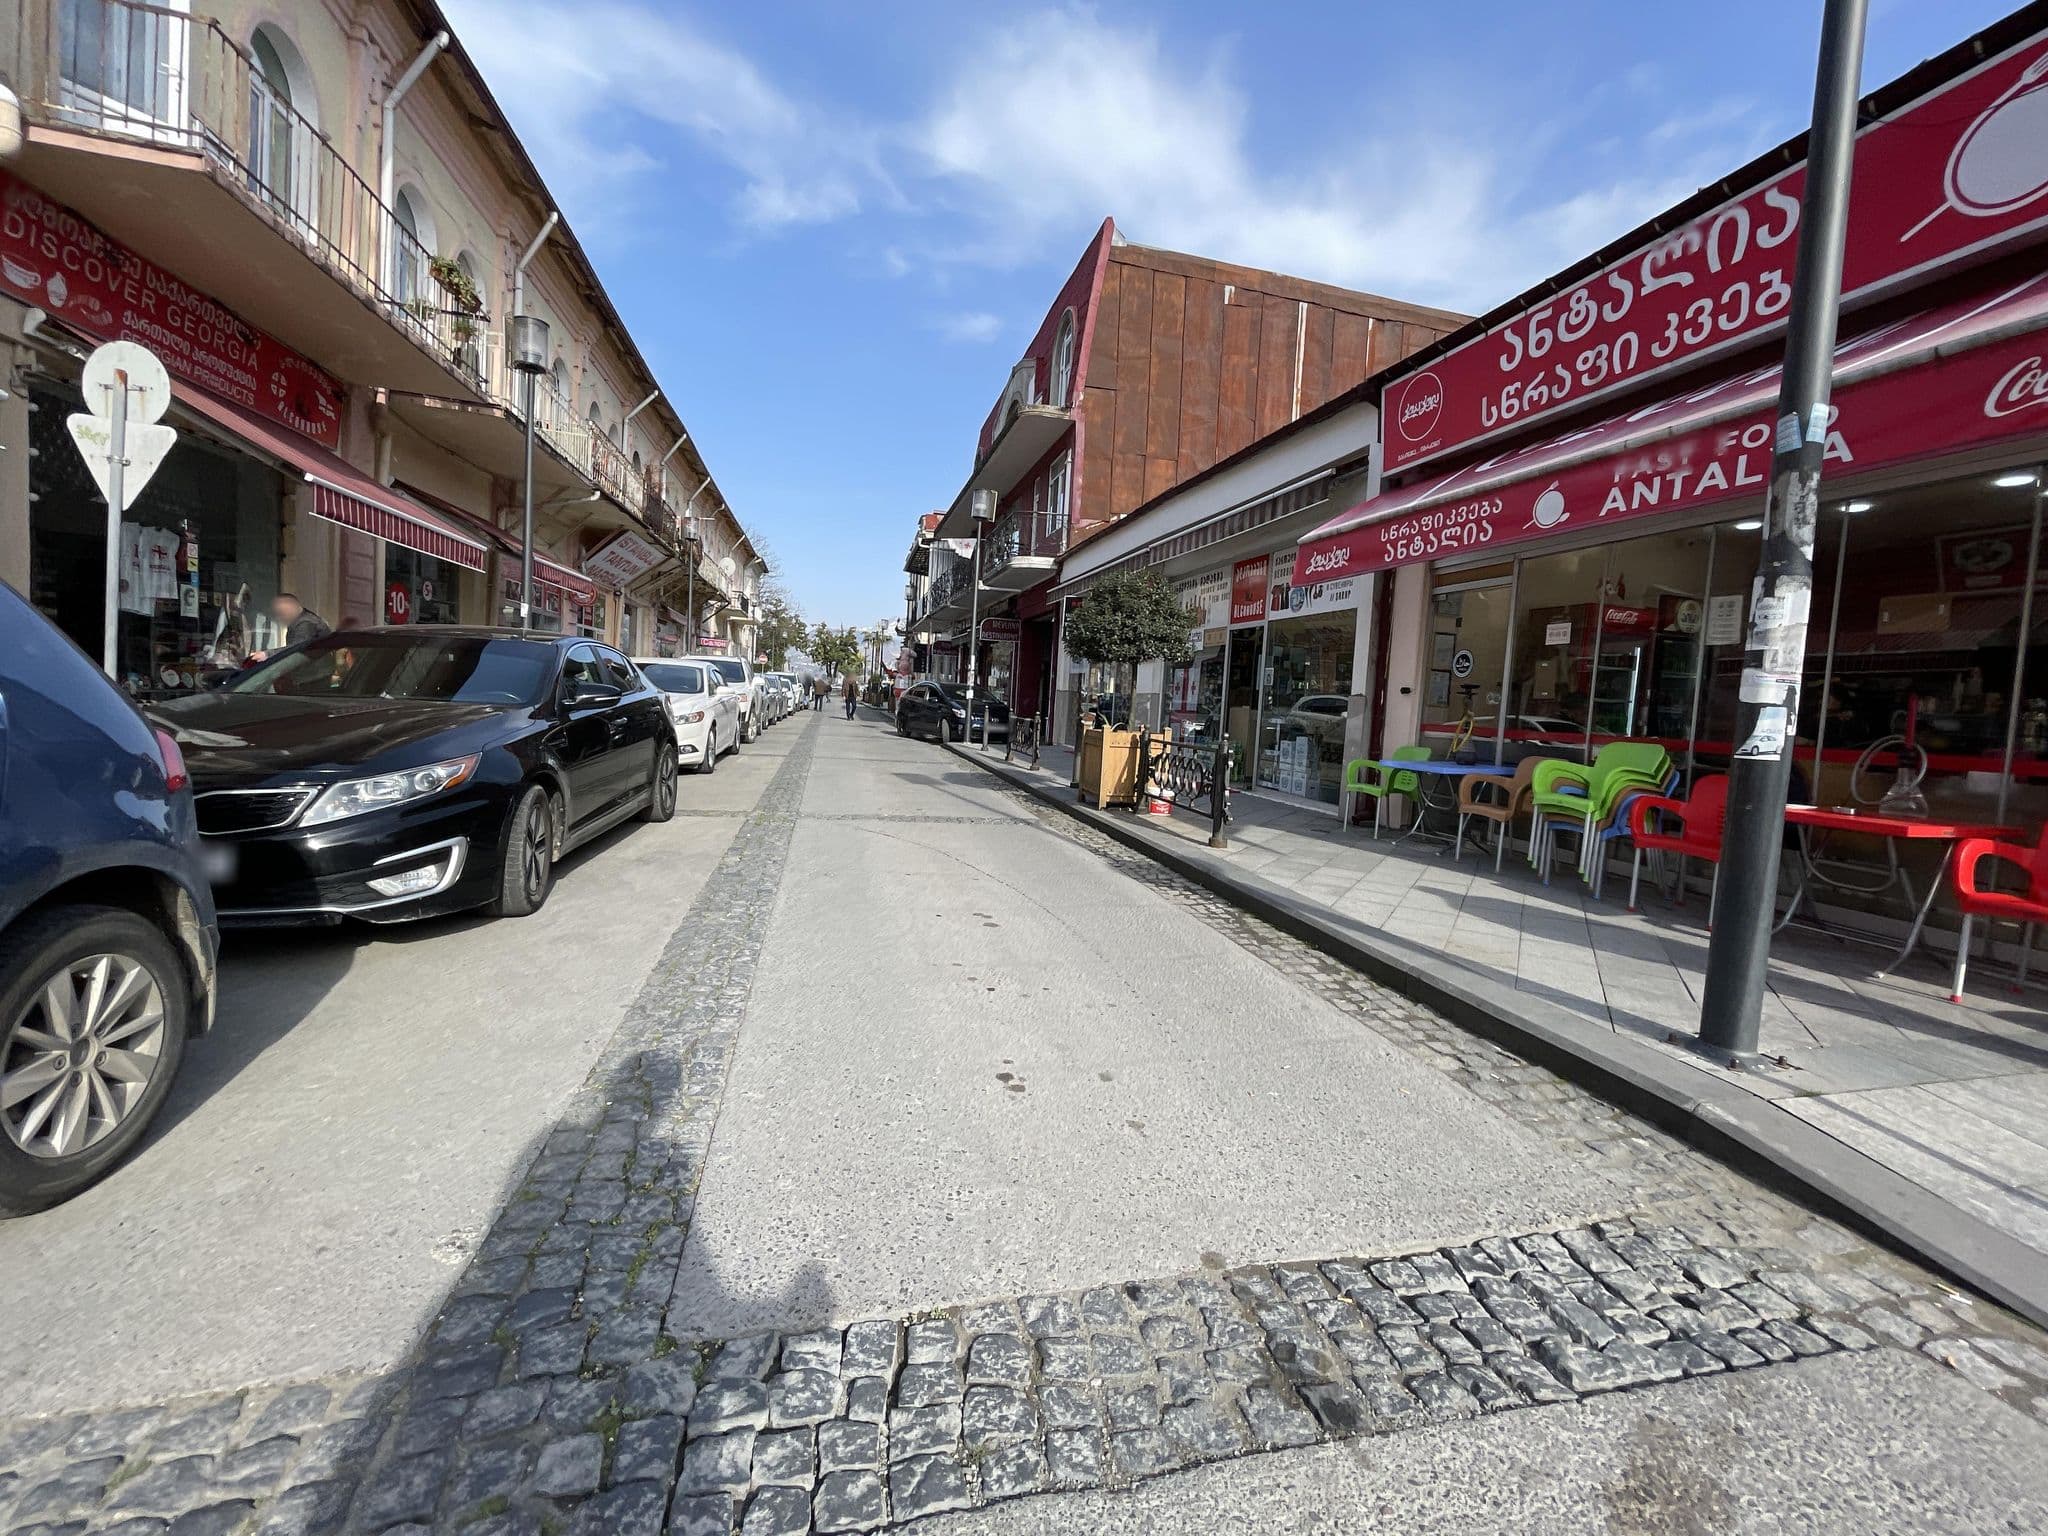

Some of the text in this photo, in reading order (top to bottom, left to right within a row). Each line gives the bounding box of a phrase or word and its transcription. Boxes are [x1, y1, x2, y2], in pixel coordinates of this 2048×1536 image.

[4, 212, 259, 371] DISCOVER GEORGIA
[1499, 185, 1802, 372] ანტალია
[122, 310, 190, 355] ქართული
[1480, 268, 1792, 428] სწრაფი კვებ
[193, 366, 255, 405] PRODUCTS
[1599, 430, 1855, 518] ANTALA
[1384, 519, 1493, 562] ანტალია
